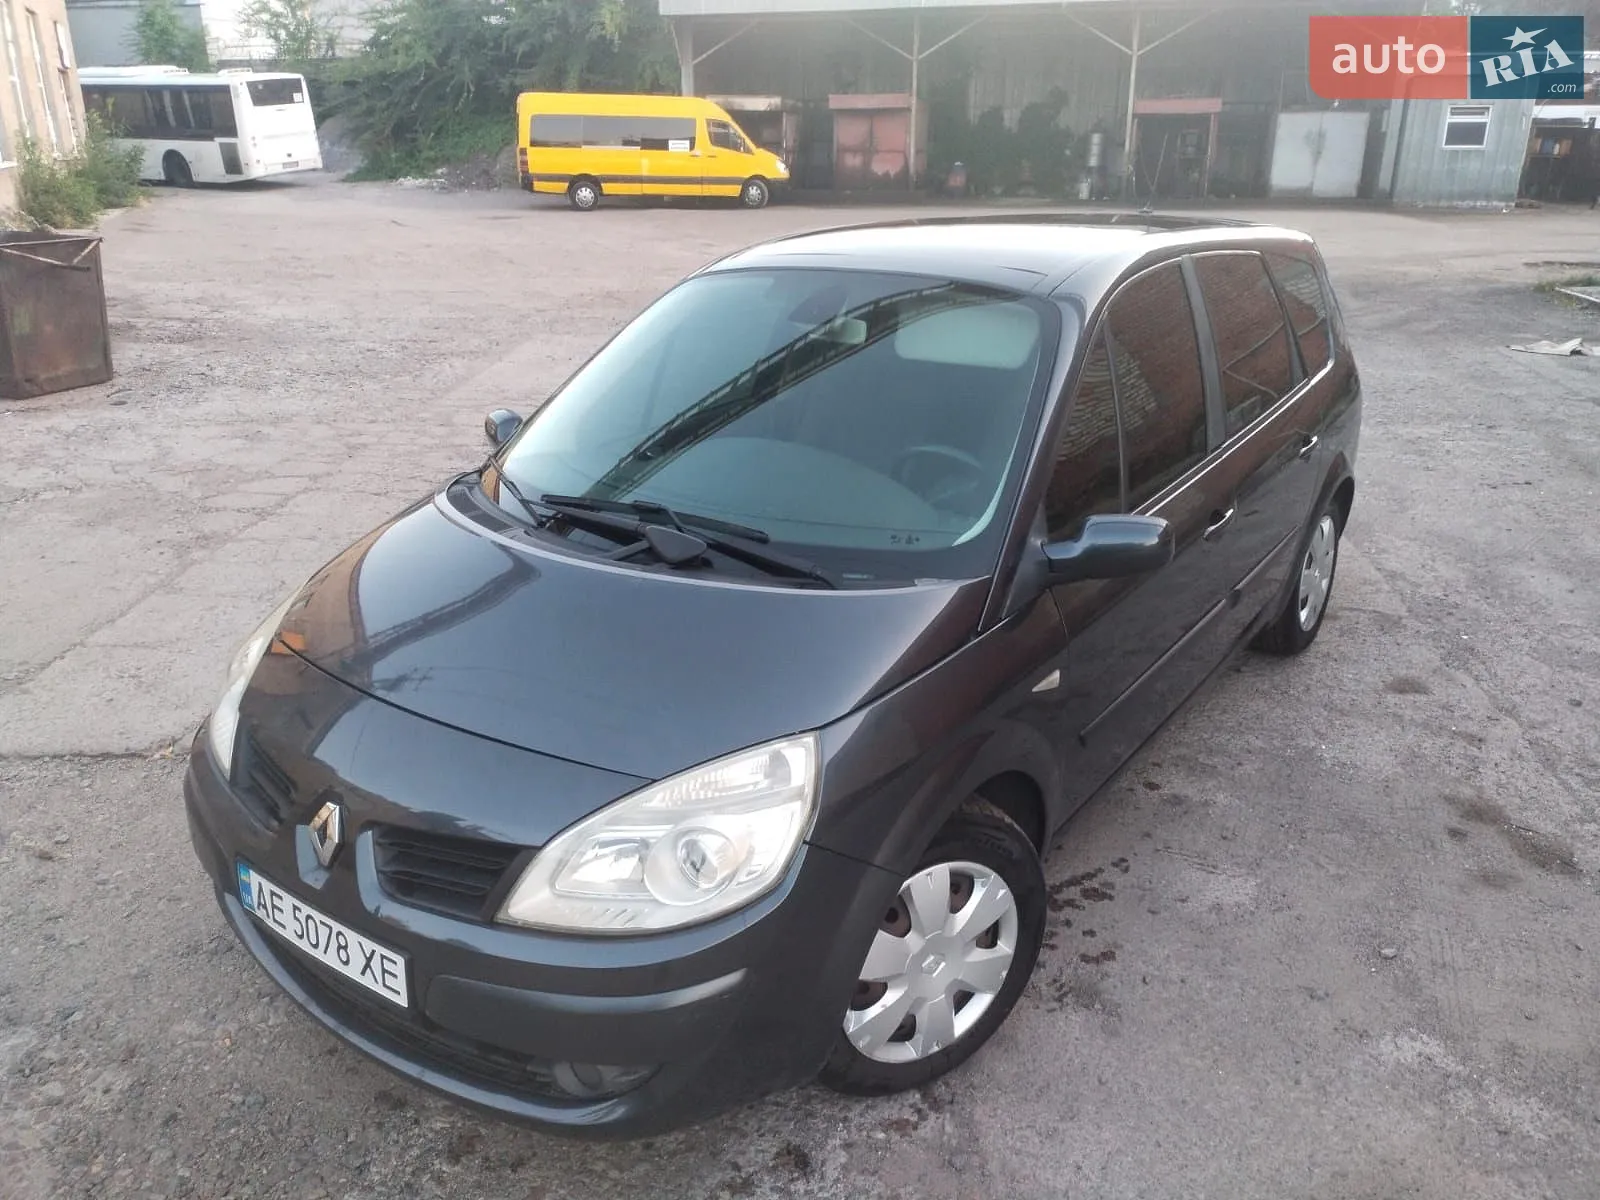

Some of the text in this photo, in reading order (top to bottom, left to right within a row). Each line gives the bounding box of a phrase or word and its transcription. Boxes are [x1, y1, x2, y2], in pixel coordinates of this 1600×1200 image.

[257, 881, 401, 996] AE 5078 XE
